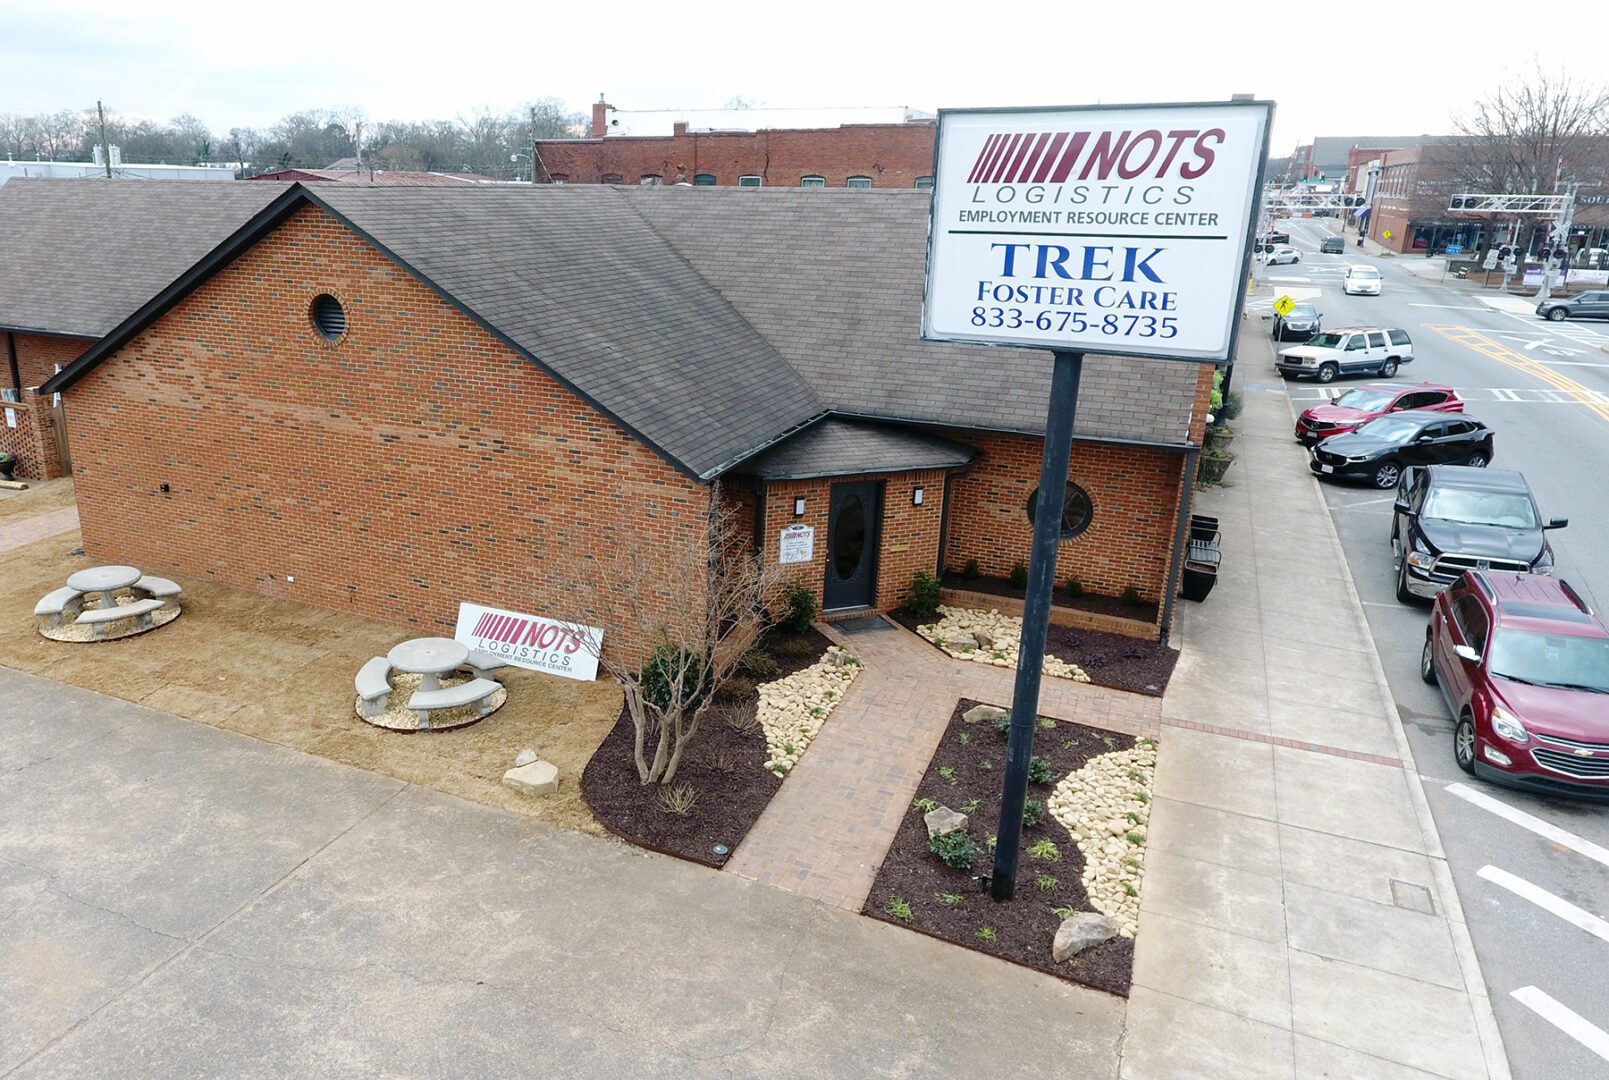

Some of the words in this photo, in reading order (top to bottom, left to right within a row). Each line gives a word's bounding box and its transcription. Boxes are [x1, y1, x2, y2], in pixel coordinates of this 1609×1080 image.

[1077, 127, 1226, 181] NOTS
[971, 185, 1195, 205] LOGISTICS
[958, 210, 1062, 224] EMPLOYMENT
[1067, 211, 1149, 225] RESOURCE
[1154, 212, 1219, 226] CENTER
[990, 242, 1169, 284] TREK
[977, 280, 1086, 307] FOSTER
[1093, 286, 1178, 312] CARE
[971, 306, 1178, 339] 833-675-8735
[478, 638, 572, 666] LOGISTICS
[519, 621, 585, 655] NOTS
[514, 656, 547, 667] RESOURCE
[547, 663, 573, 673] CENTER
